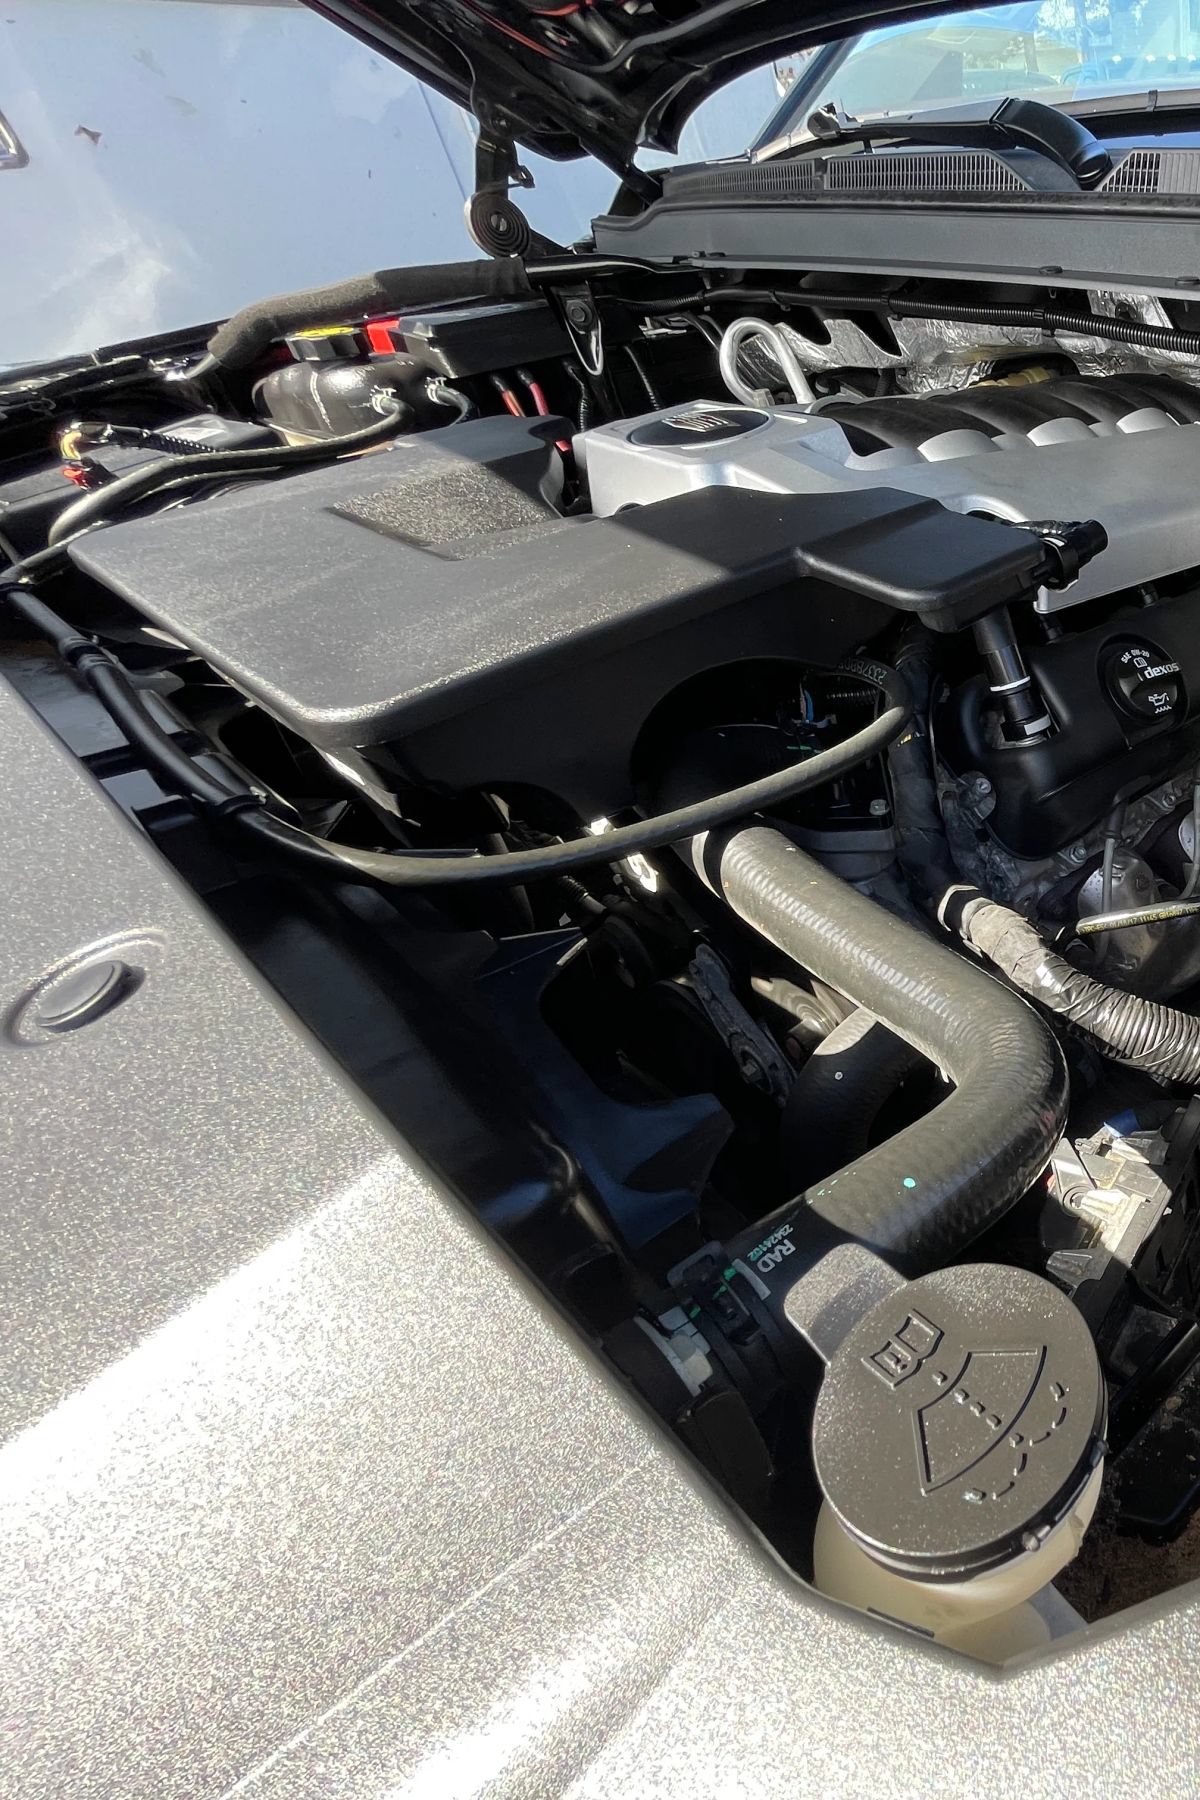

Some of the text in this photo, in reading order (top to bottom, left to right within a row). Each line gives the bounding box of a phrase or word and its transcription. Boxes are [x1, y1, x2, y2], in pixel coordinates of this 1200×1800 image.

[1121, 651, 1132, 664] SAE
[1143, 662, 1180, 679] dexos
[757, 1239, 796, 1273] RAD
